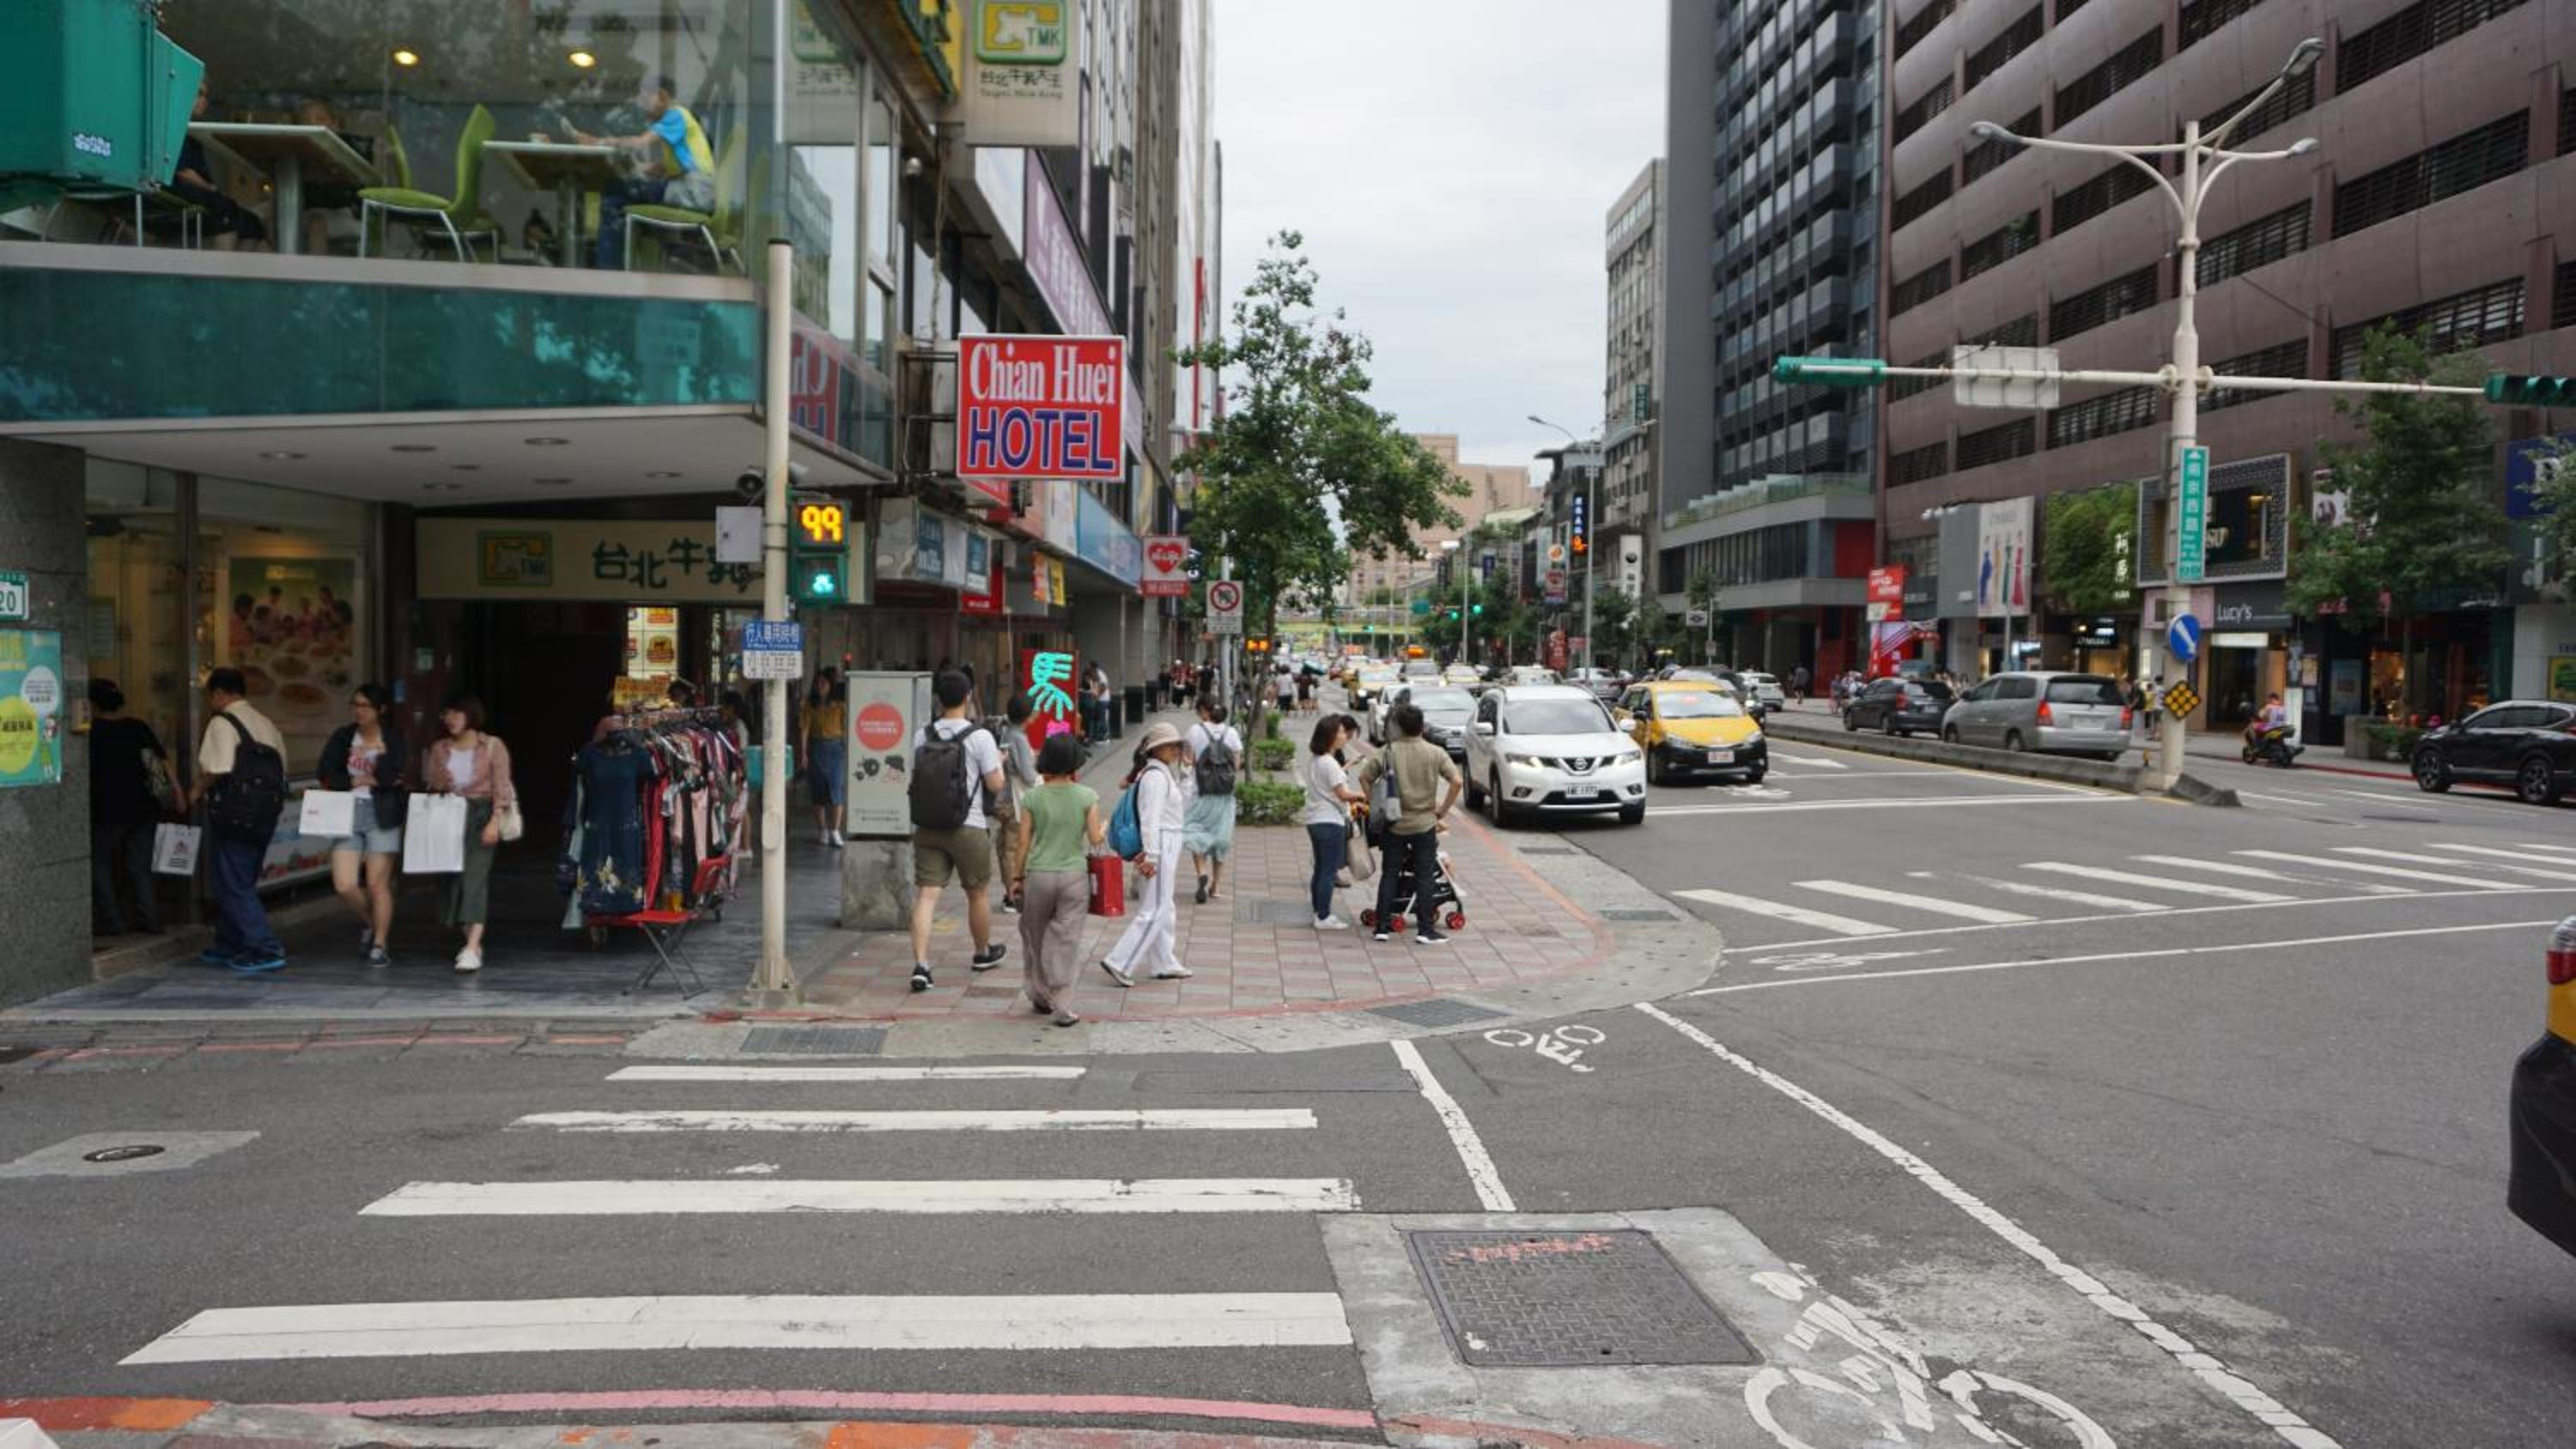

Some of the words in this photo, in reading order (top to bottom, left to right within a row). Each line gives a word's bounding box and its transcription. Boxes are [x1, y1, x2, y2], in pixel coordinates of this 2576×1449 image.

[1025, 27, 1059, 46] TMK
[969, 343, 1045, 401] Chian
[1052, 345, 1116, 404] Huei
[967, 406, 1115, 471] HOTEL
[801, 505, 842, 542] 99
[2217, 603, 2252, 625] Lucy's
